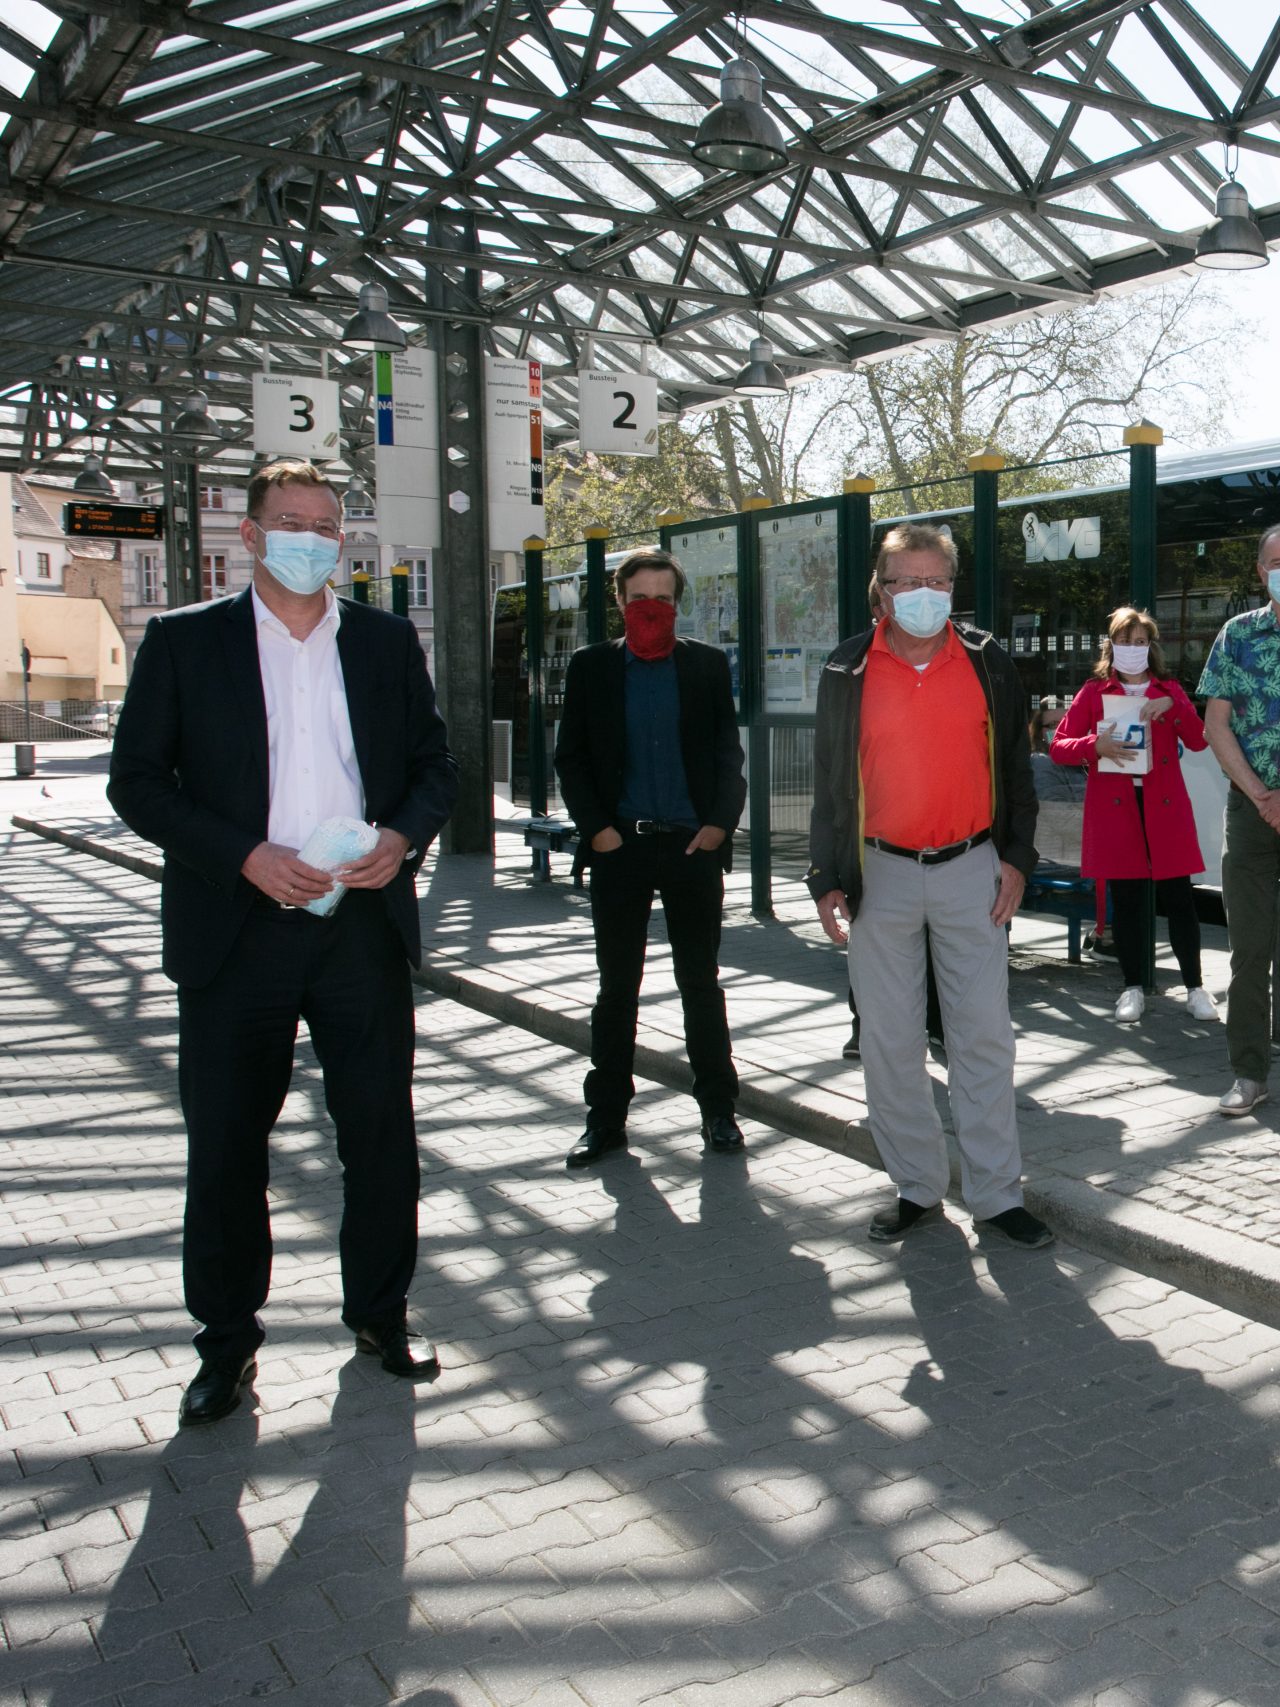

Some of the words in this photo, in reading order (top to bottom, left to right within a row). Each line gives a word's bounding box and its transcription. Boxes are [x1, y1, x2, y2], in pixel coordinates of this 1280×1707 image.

[530, 367, 540, 377] 10
[262, 377, 293, 387] Bussteig
[589, 373, 618, 384] Bussteig
[530, 385, 539, 395] 11
[378, 401, 393, 411] N4
[613, 391, 638, 430] 2
[289, 394, 315, 433] 3
[531, 415, 541, 424] 51
[531, 464, 542, 473] N9
